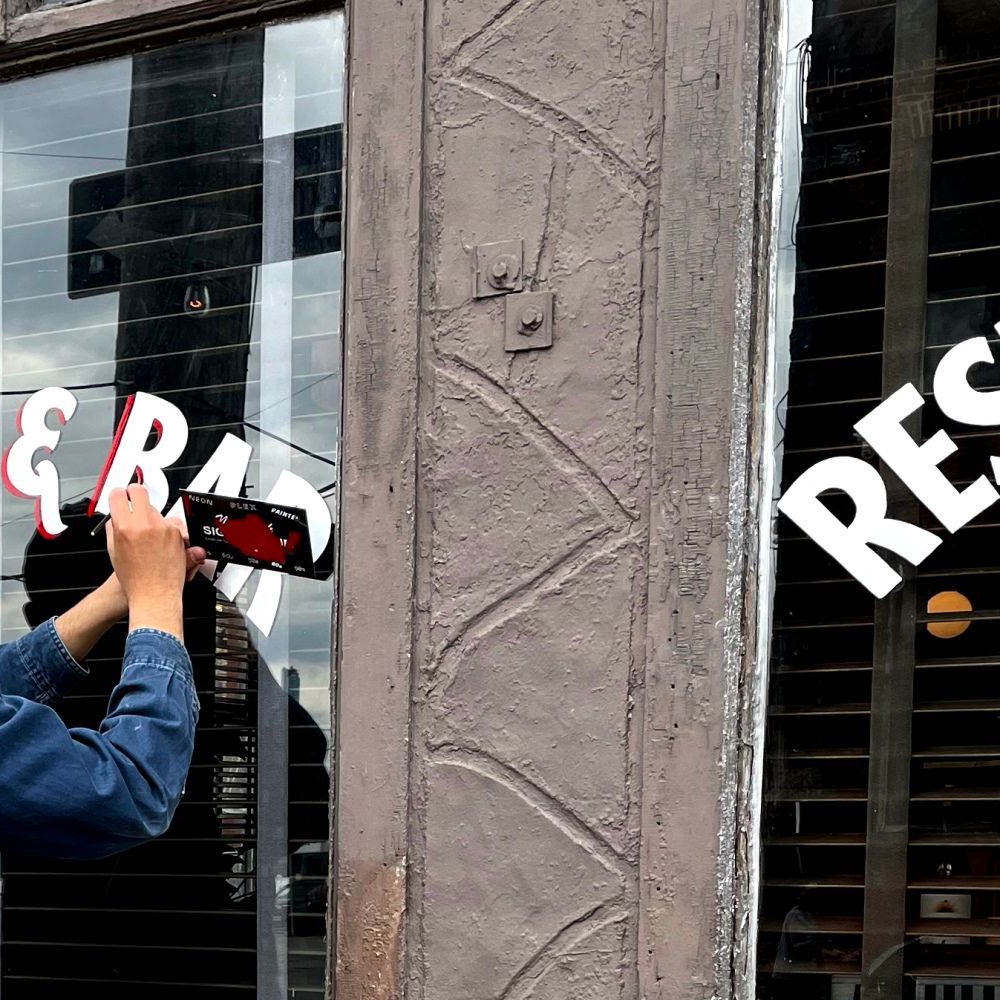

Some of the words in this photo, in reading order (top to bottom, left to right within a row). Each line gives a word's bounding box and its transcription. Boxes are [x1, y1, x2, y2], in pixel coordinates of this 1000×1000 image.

[0, 386, 78, 540] &
[188, 494, 213, 506] NEON
[230, 502, 258, 511] PLEX
[777, 321, 1000, 599] RES
